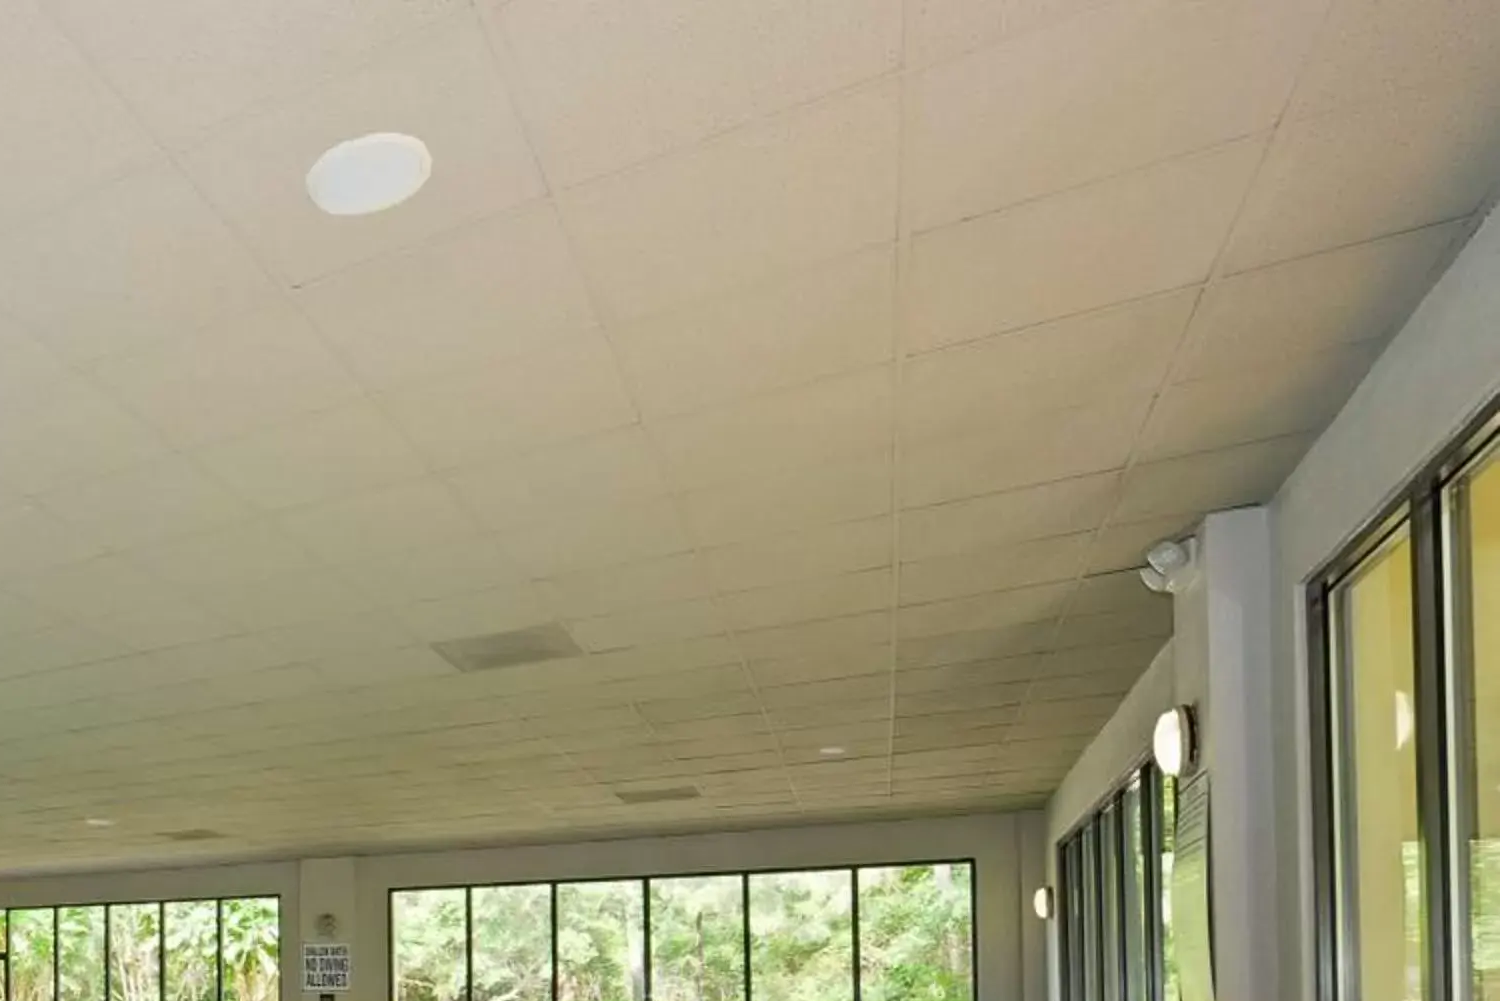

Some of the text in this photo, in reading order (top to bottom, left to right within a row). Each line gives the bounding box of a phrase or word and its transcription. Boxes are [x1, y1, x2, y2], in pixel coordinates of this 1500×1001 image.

[305, 957, 348, 973] NO DIVING
[305, 973, 347, 987] ALLOWED
